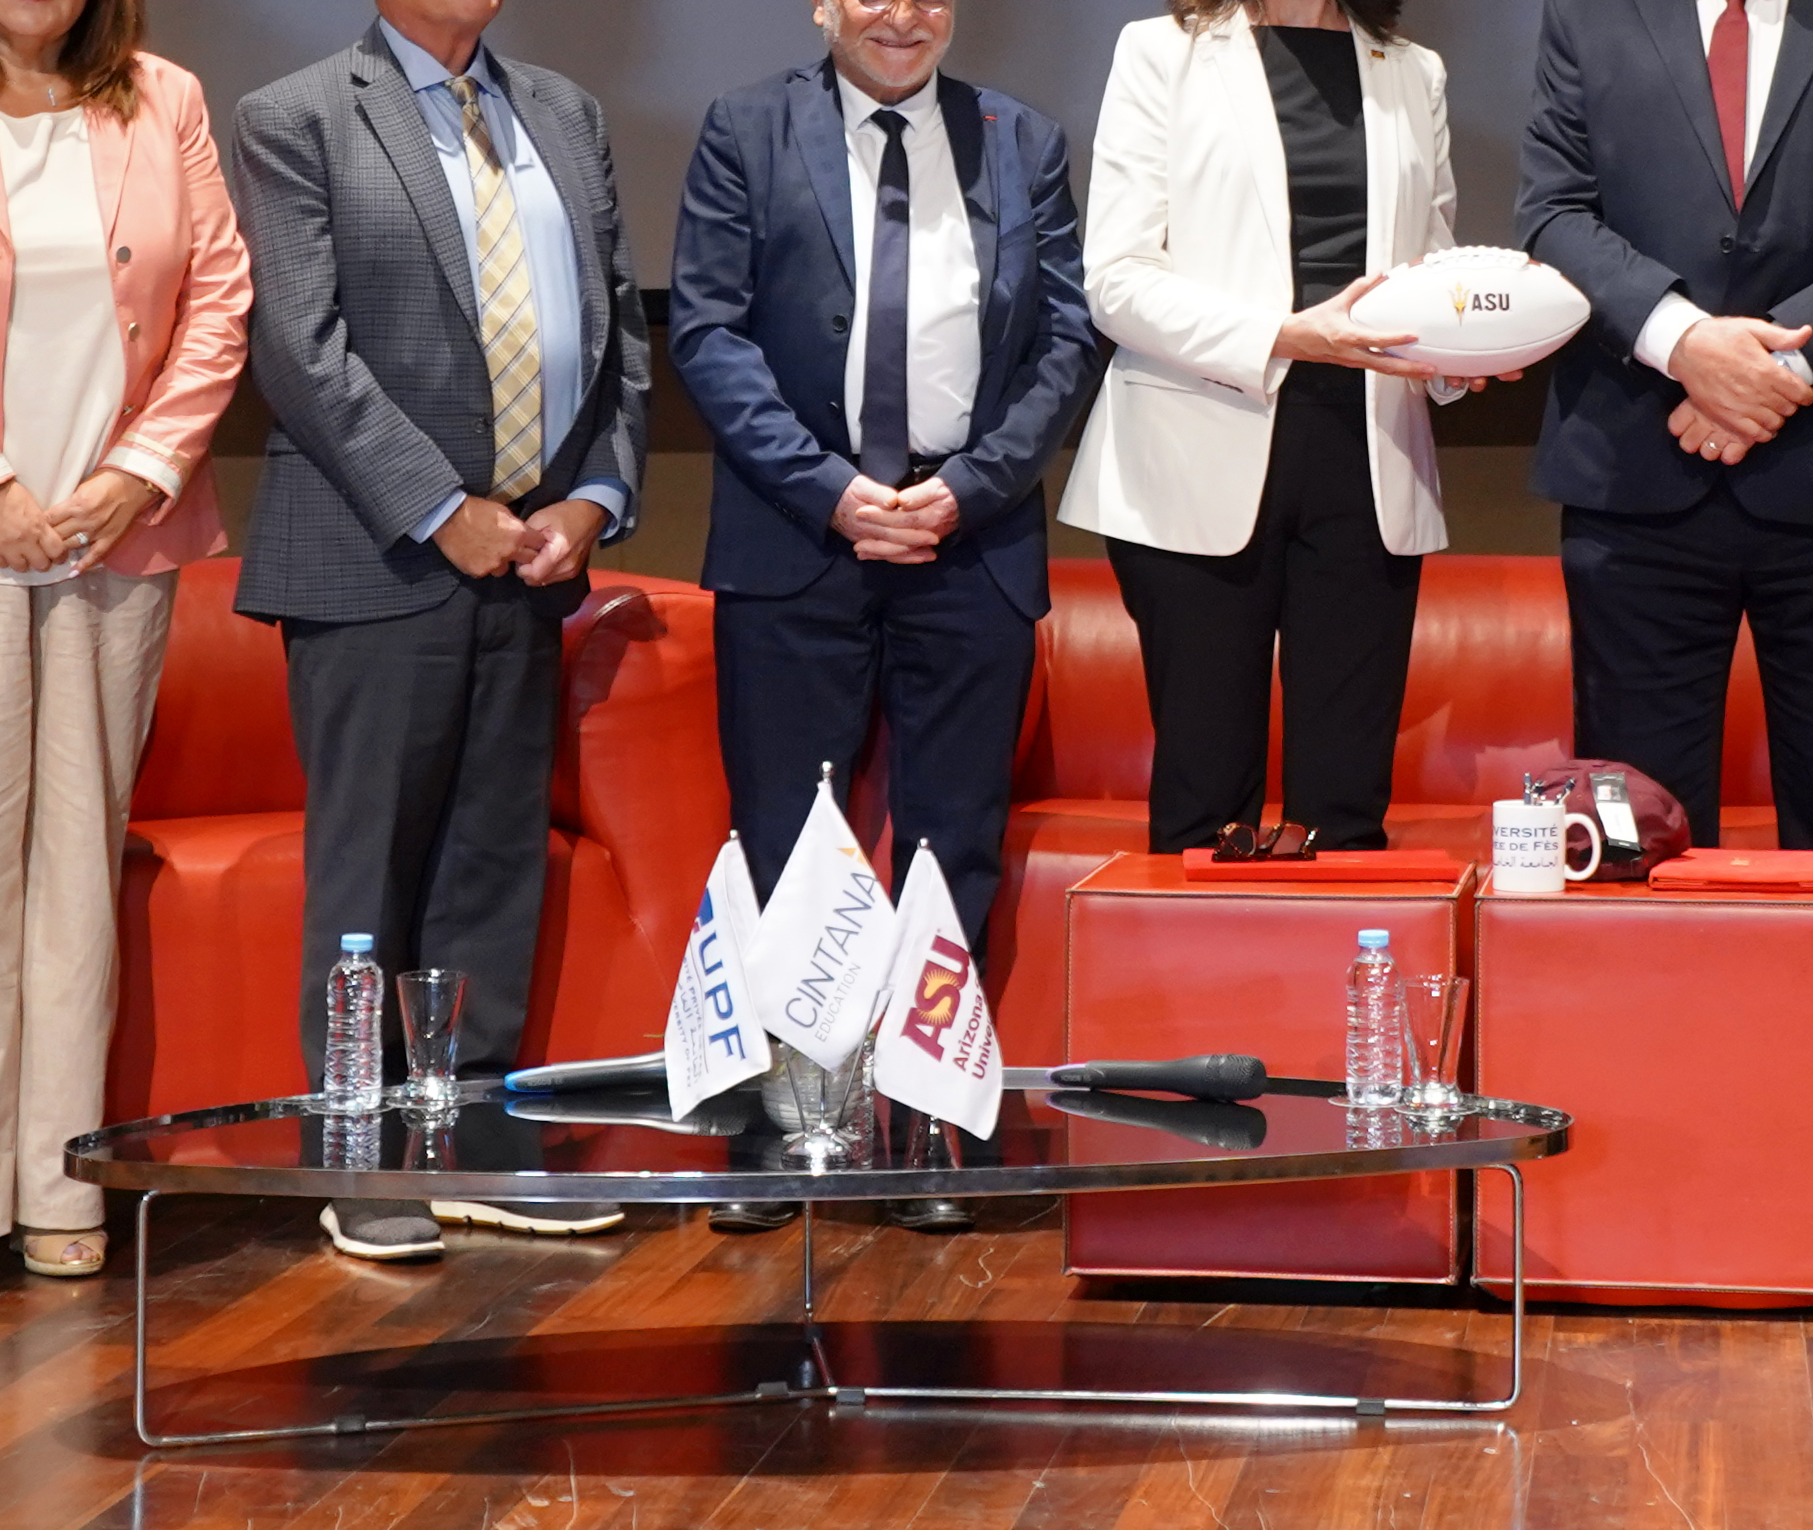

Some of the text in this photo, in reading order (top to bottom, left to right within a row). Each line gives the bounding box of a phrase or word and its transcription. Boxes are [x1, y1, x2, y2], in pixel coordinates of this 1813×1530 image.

[1472, 293, 1510, 312] ASU
[1493, 823, 1558, 838] VERSITÉ
[785, 872, 879, 1029] CINTANA
[698, 930, 746, 1061] UPF
[814, 962, 861, 1043] EDUCATION
[899, 934, 971, 1062] ASU
[953, 994, 983, 1073] Arizona
